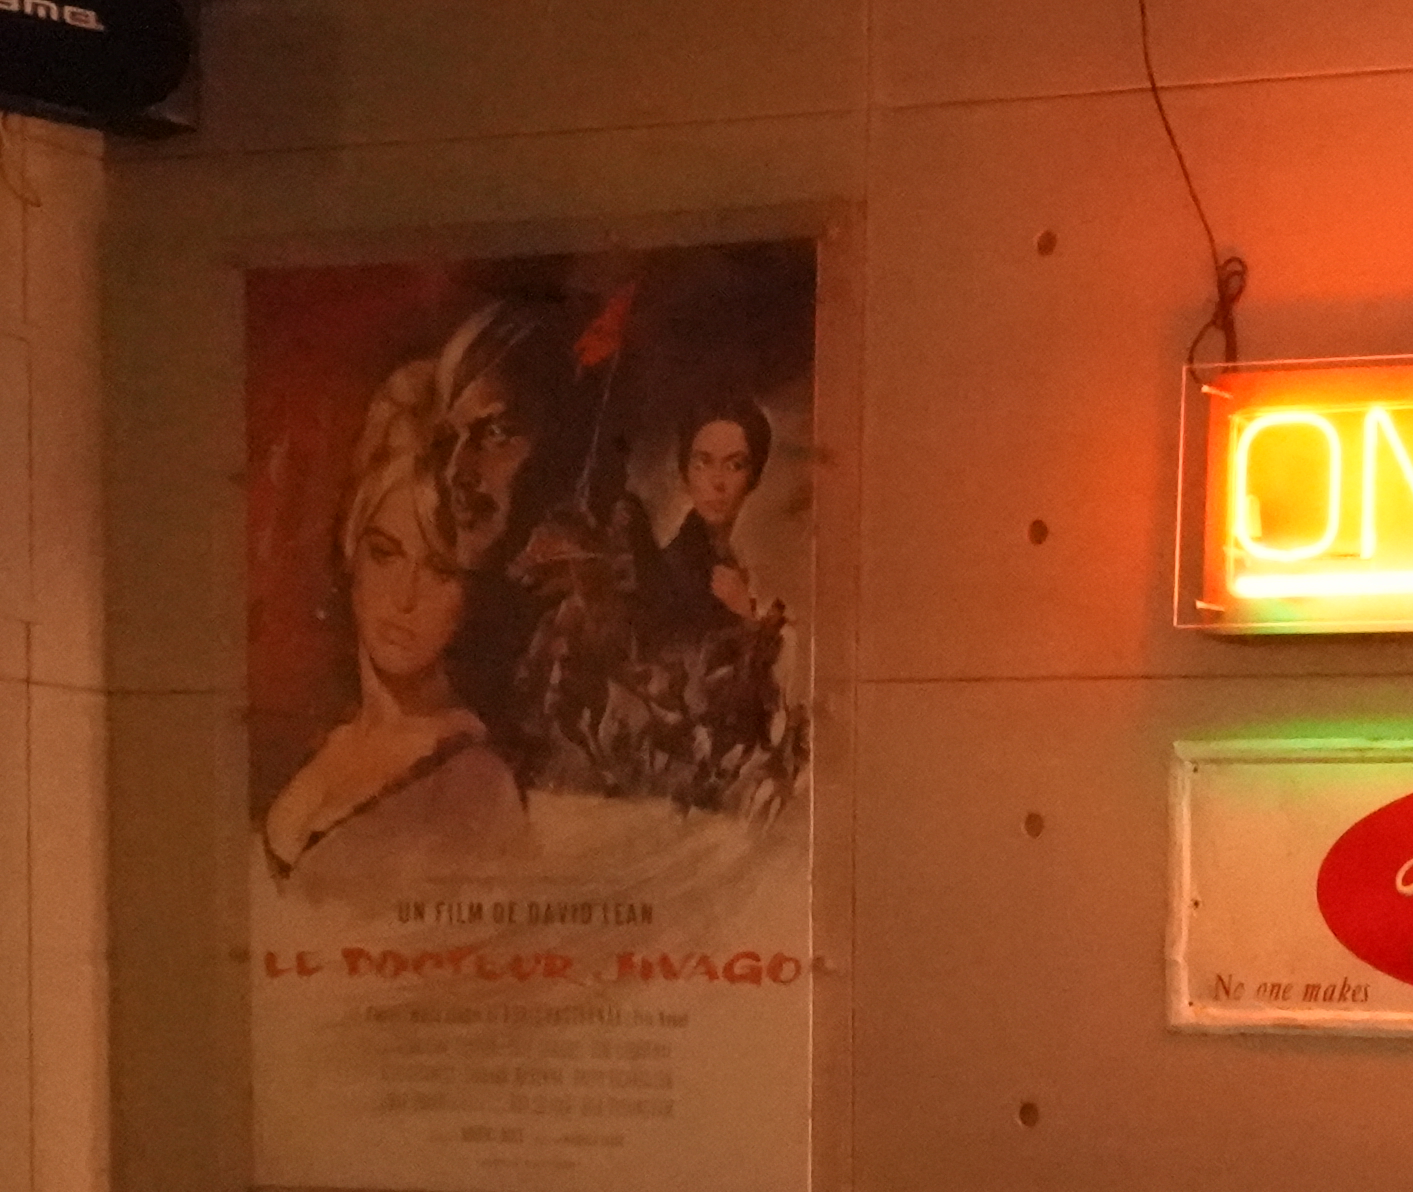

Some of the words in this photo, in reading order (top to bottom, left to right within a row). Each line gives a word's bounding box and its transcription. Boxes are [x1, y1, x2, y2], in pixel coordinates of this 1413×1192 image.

[399, 902, 425, 924] UN
[434, 902, 483, 925] FILM
[492, 903, 518, 925] DE
[527, 903, 593, 926] DAVID
[602, 904, 653, 926] LEAN
[1213, 974, 1245, 1000] No
[1256, 982, 1294, 1002] one
[1302, 977, 1371, 1003] makes
